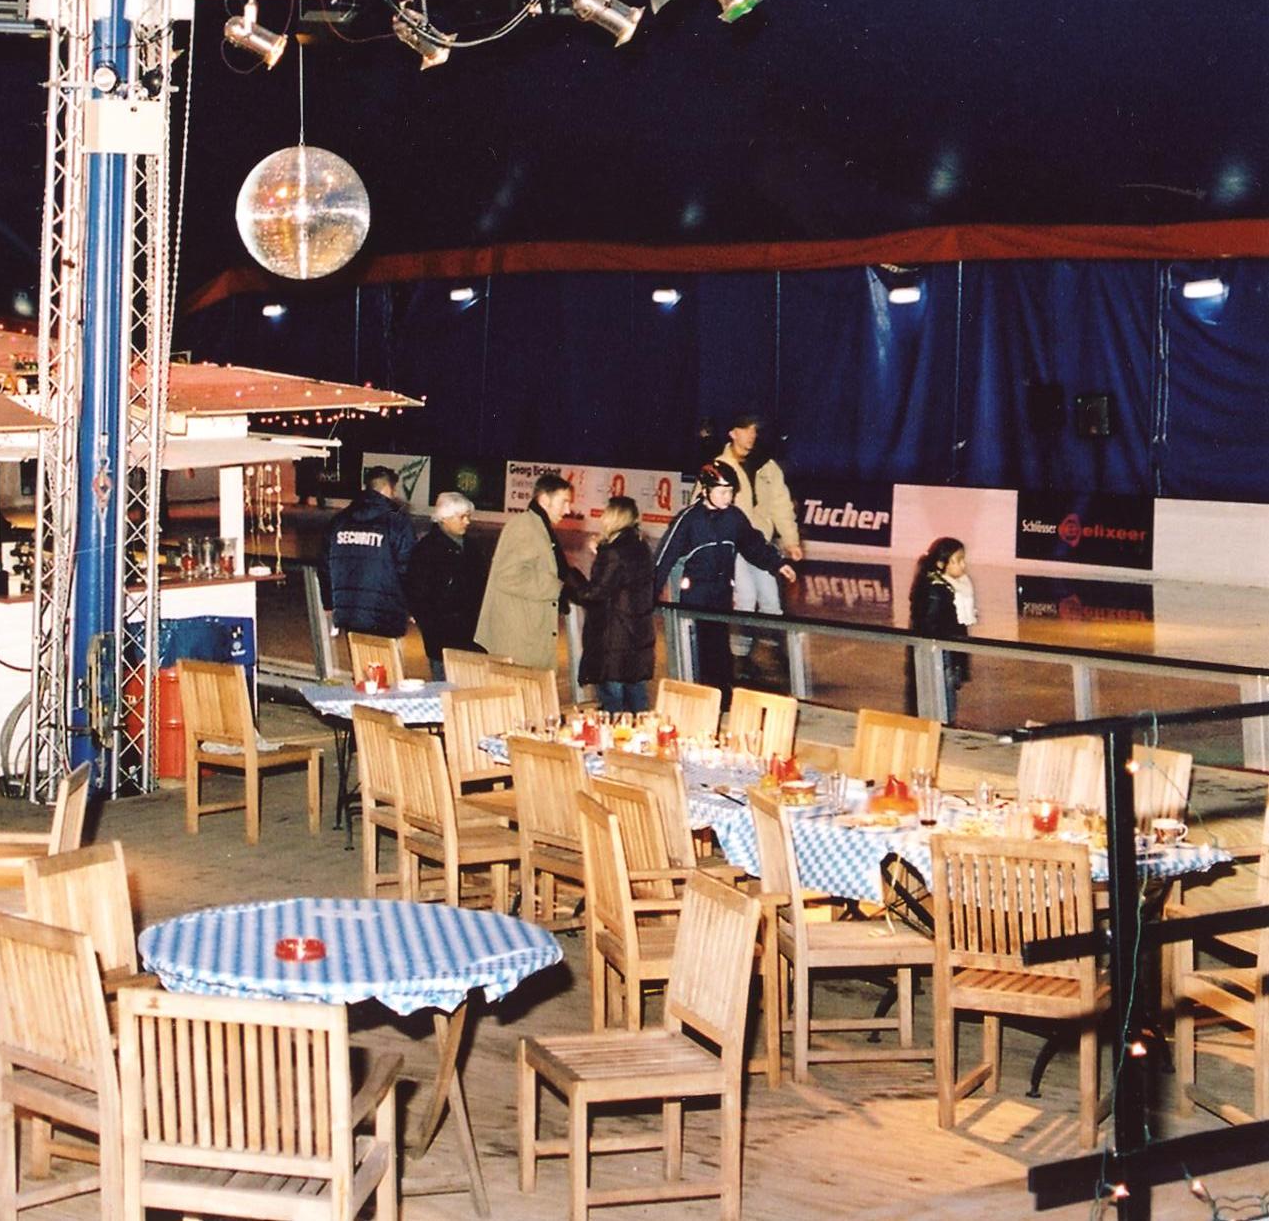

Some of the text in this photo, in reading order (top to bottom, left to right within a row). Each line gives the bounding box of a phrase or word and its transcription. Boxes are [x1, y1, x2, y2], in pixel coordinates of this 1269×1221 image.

[803, 499, 890, 530] Tucher
[336, 531, 384, 548] SECURITY
[1083, 524, 1146, 542] elixeer
